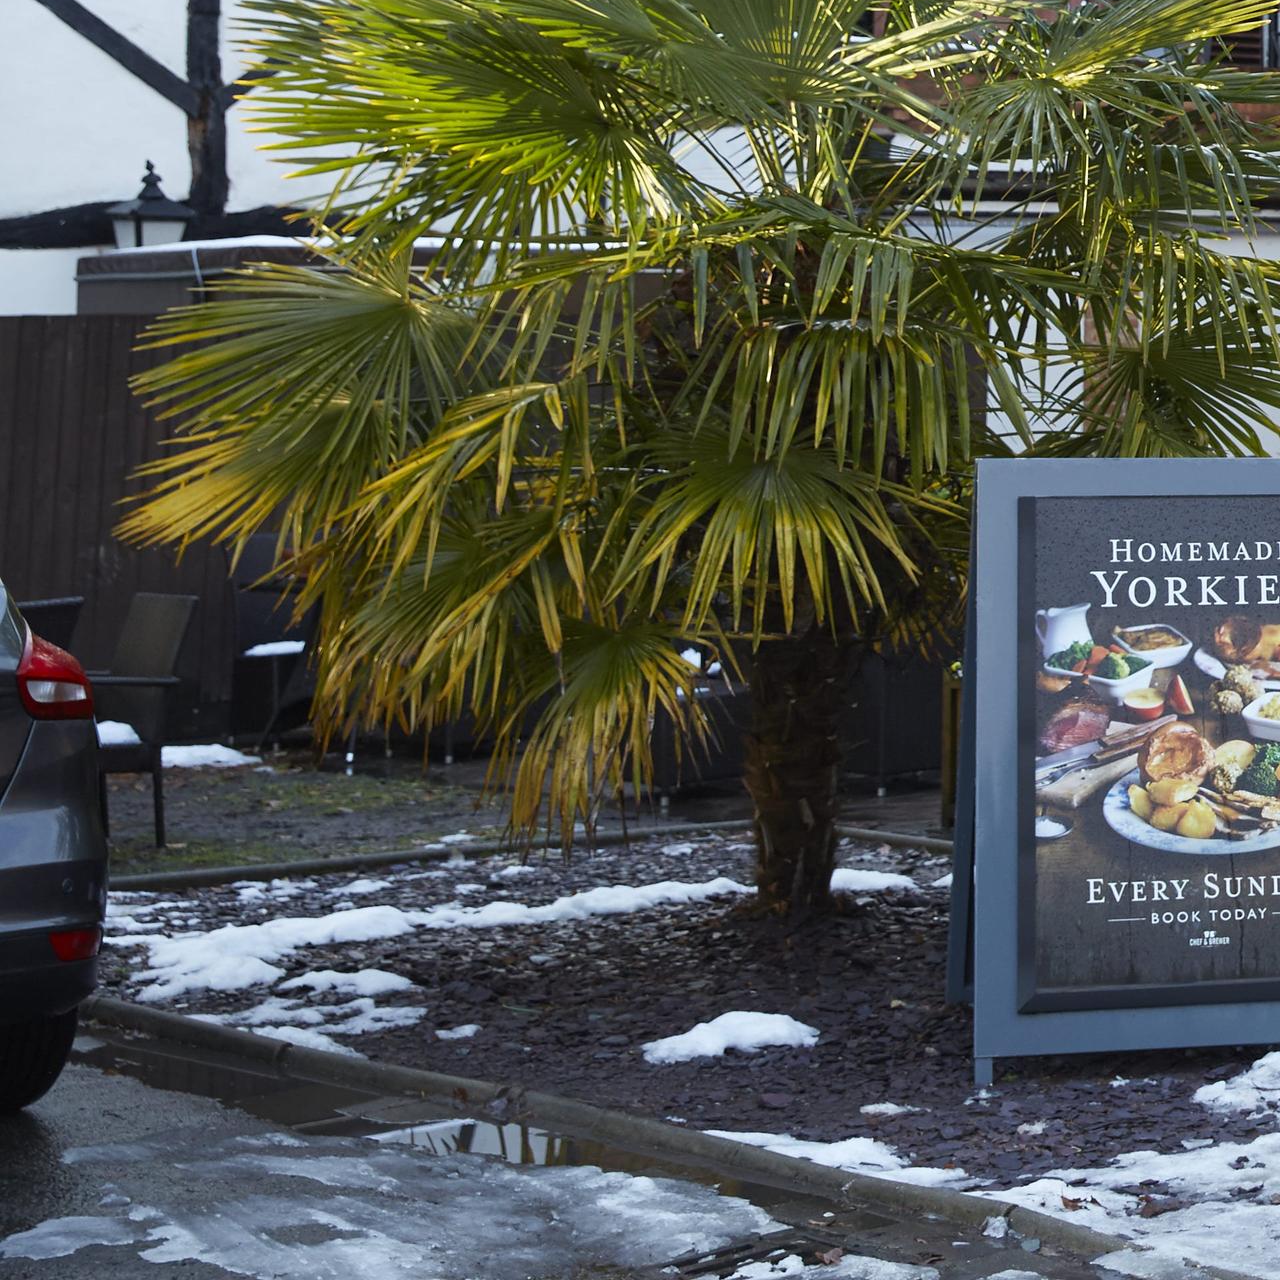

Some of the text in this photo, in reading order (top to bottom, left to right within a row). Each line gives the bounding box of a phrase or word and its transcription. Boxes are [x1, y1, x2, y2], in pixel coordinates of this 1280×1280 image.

[1086, 878, 1190, 905] EVERY
[1151, 907, 1267, 924] BOOK TODAY
